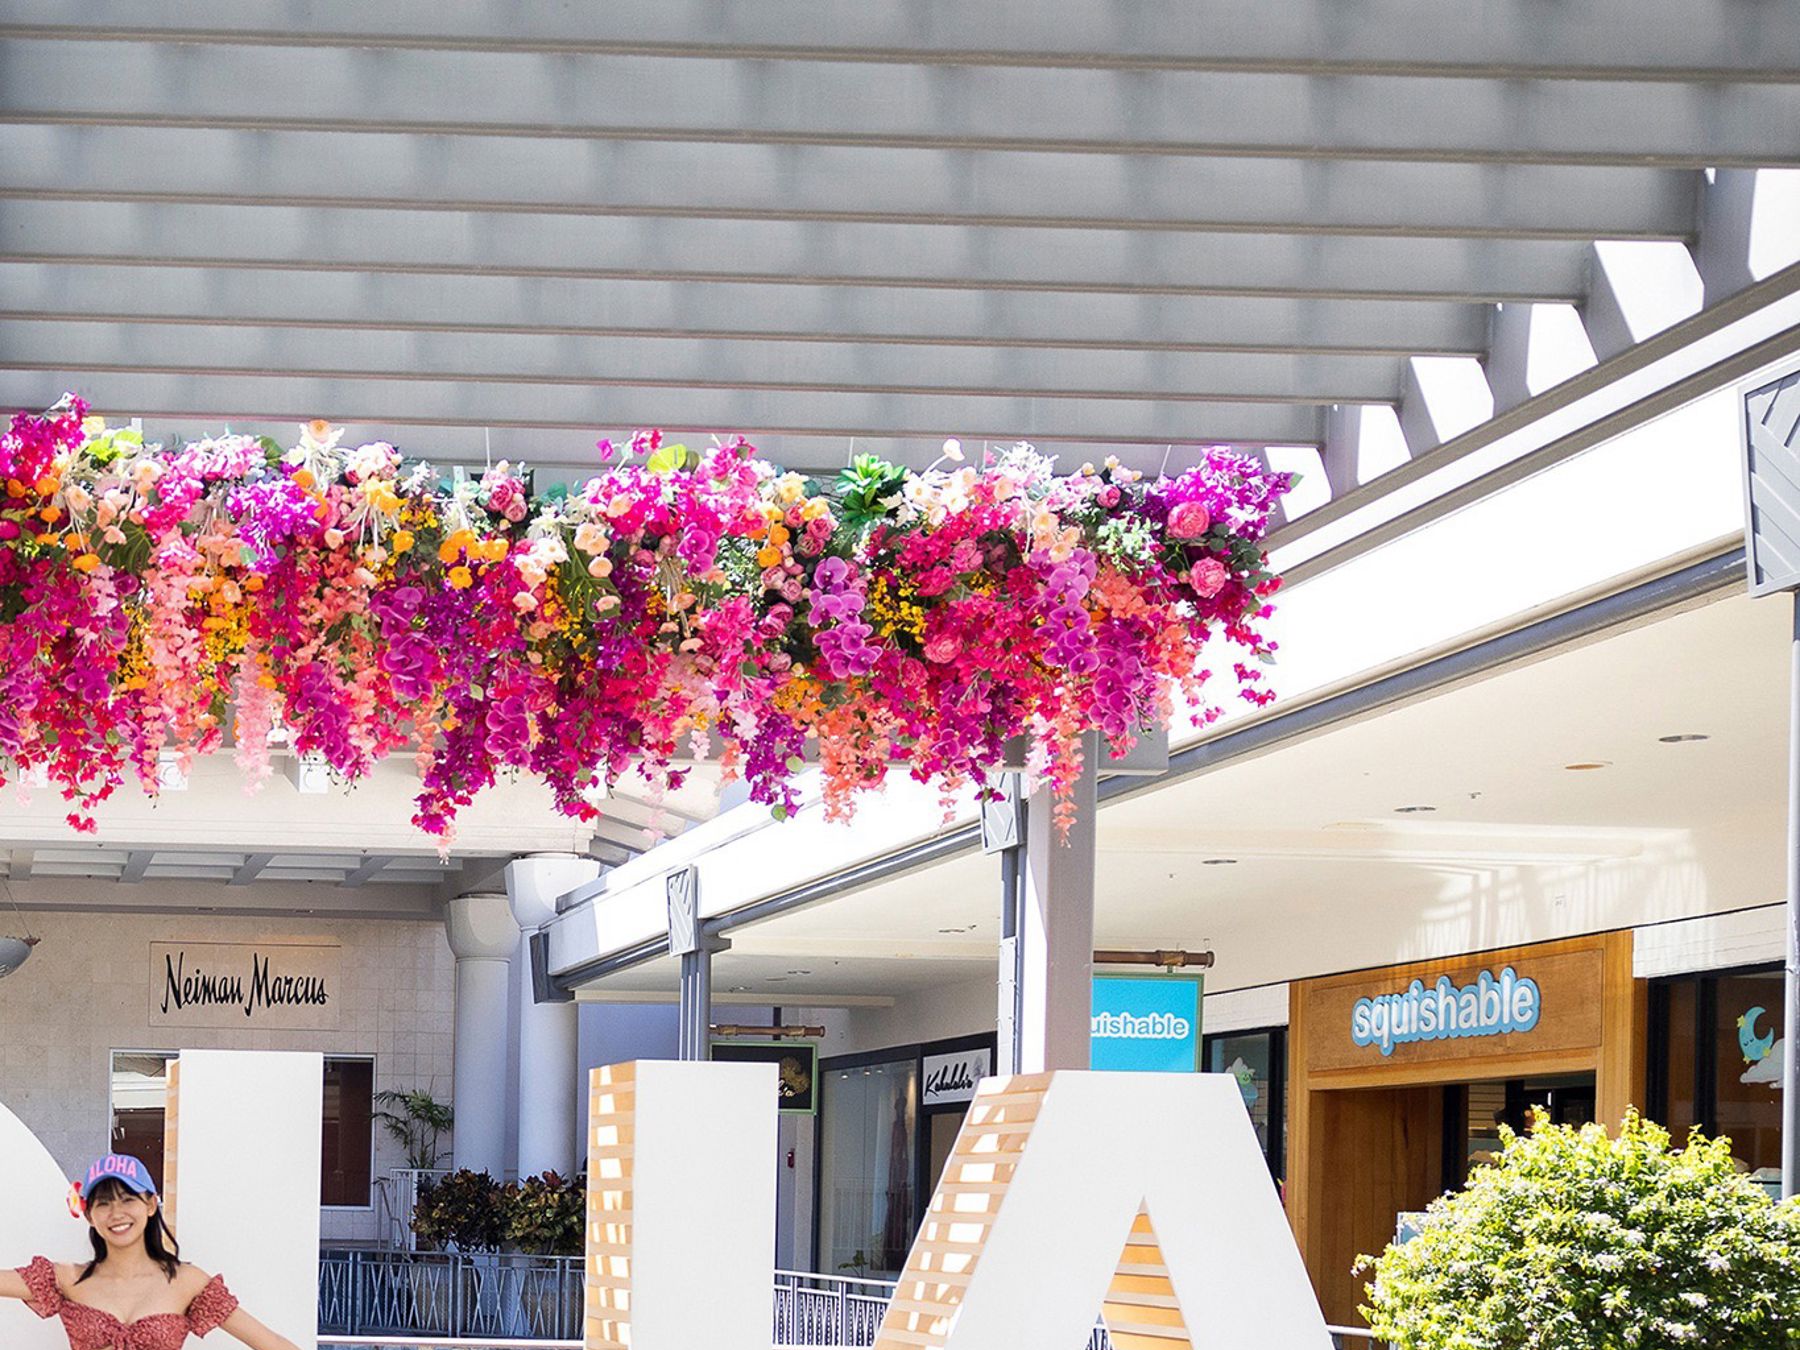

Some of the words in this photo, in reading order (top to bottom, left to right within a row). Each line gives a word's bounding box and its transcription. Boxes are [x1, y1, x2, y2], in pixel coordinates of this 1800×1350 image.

[160, 951, 244, 1014] Neiman
[244, 952, 329, 1017] Marcus
[1354, 974, 1533, 1049] squishable
[88, 1155, 137, 1184] ALOHA
